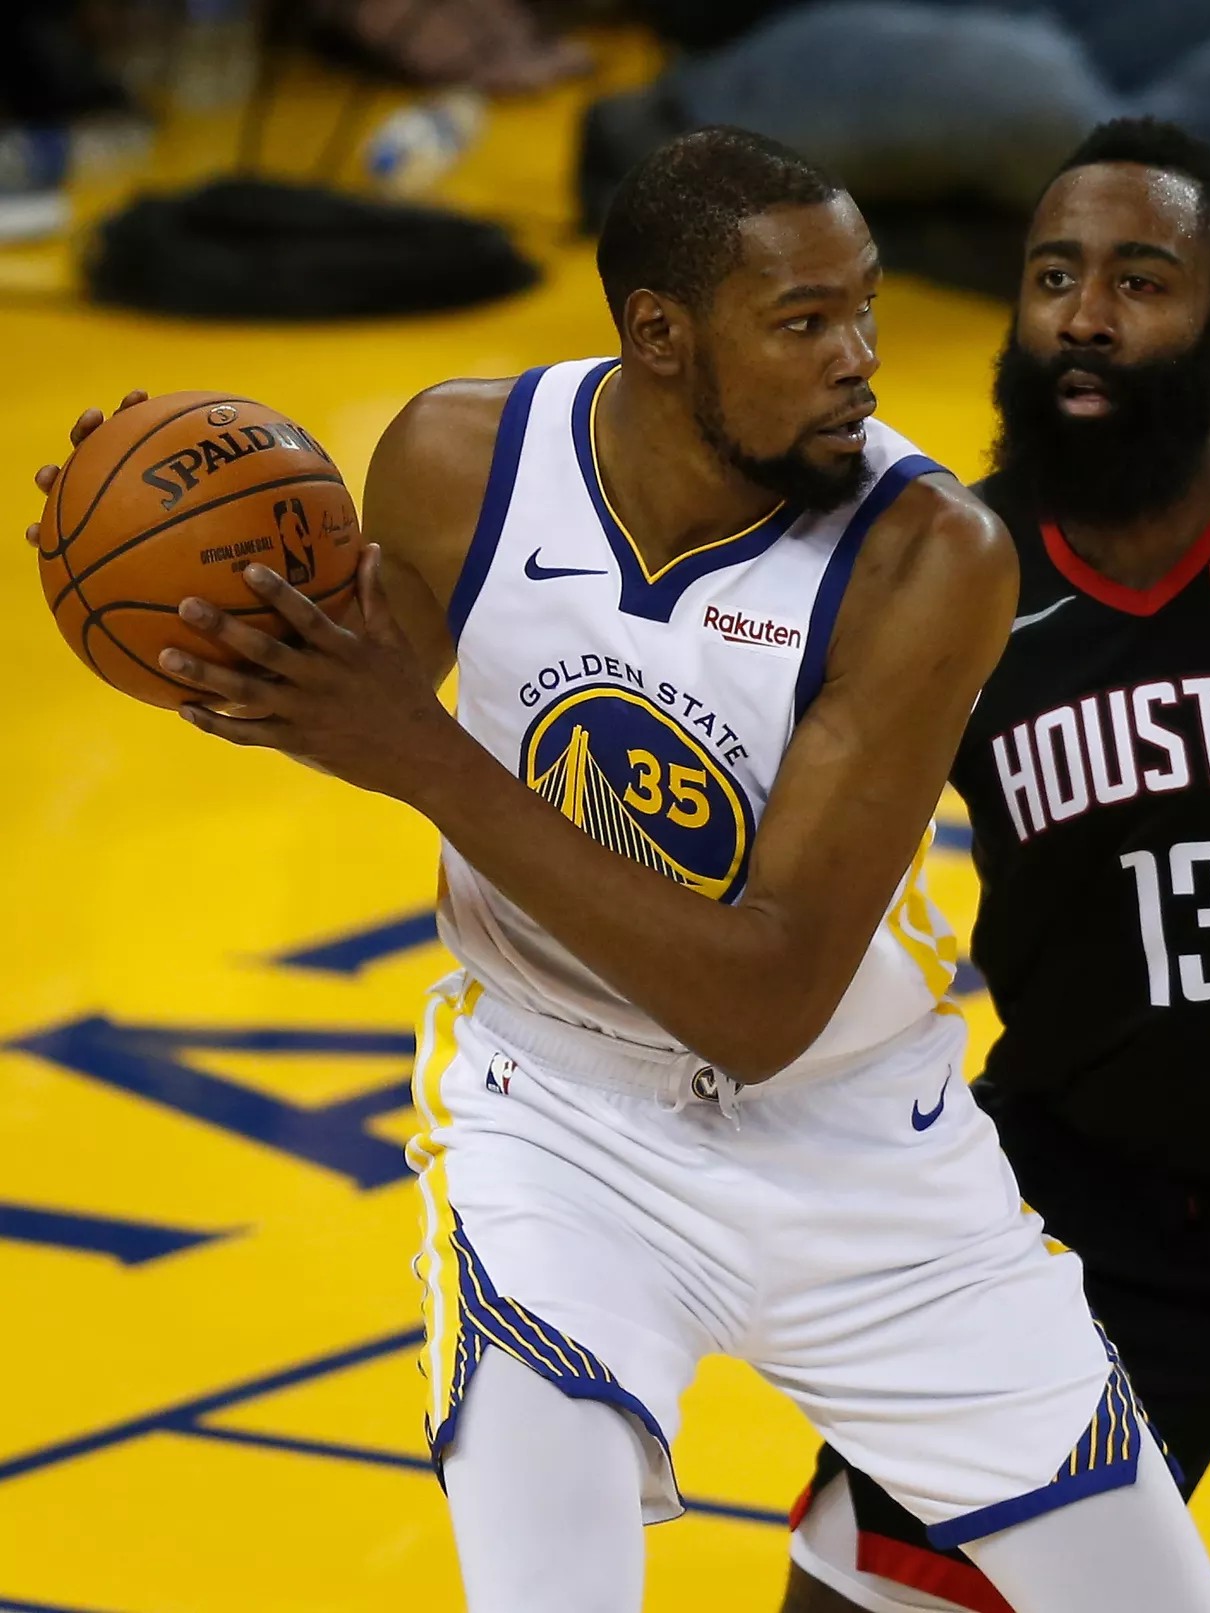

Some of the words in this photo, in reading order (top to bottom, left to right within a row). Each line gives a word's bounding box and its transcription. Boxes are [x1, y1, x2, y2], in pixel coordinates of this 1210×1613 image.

[142, 424, 331, 511] SPALDIN
[704, 605, 801, 649] Rakuten
[519, 654, 643, 707] GOLDEN
[656, 682, 749, 767] STATE
[623, 748, 711, 829] 35
